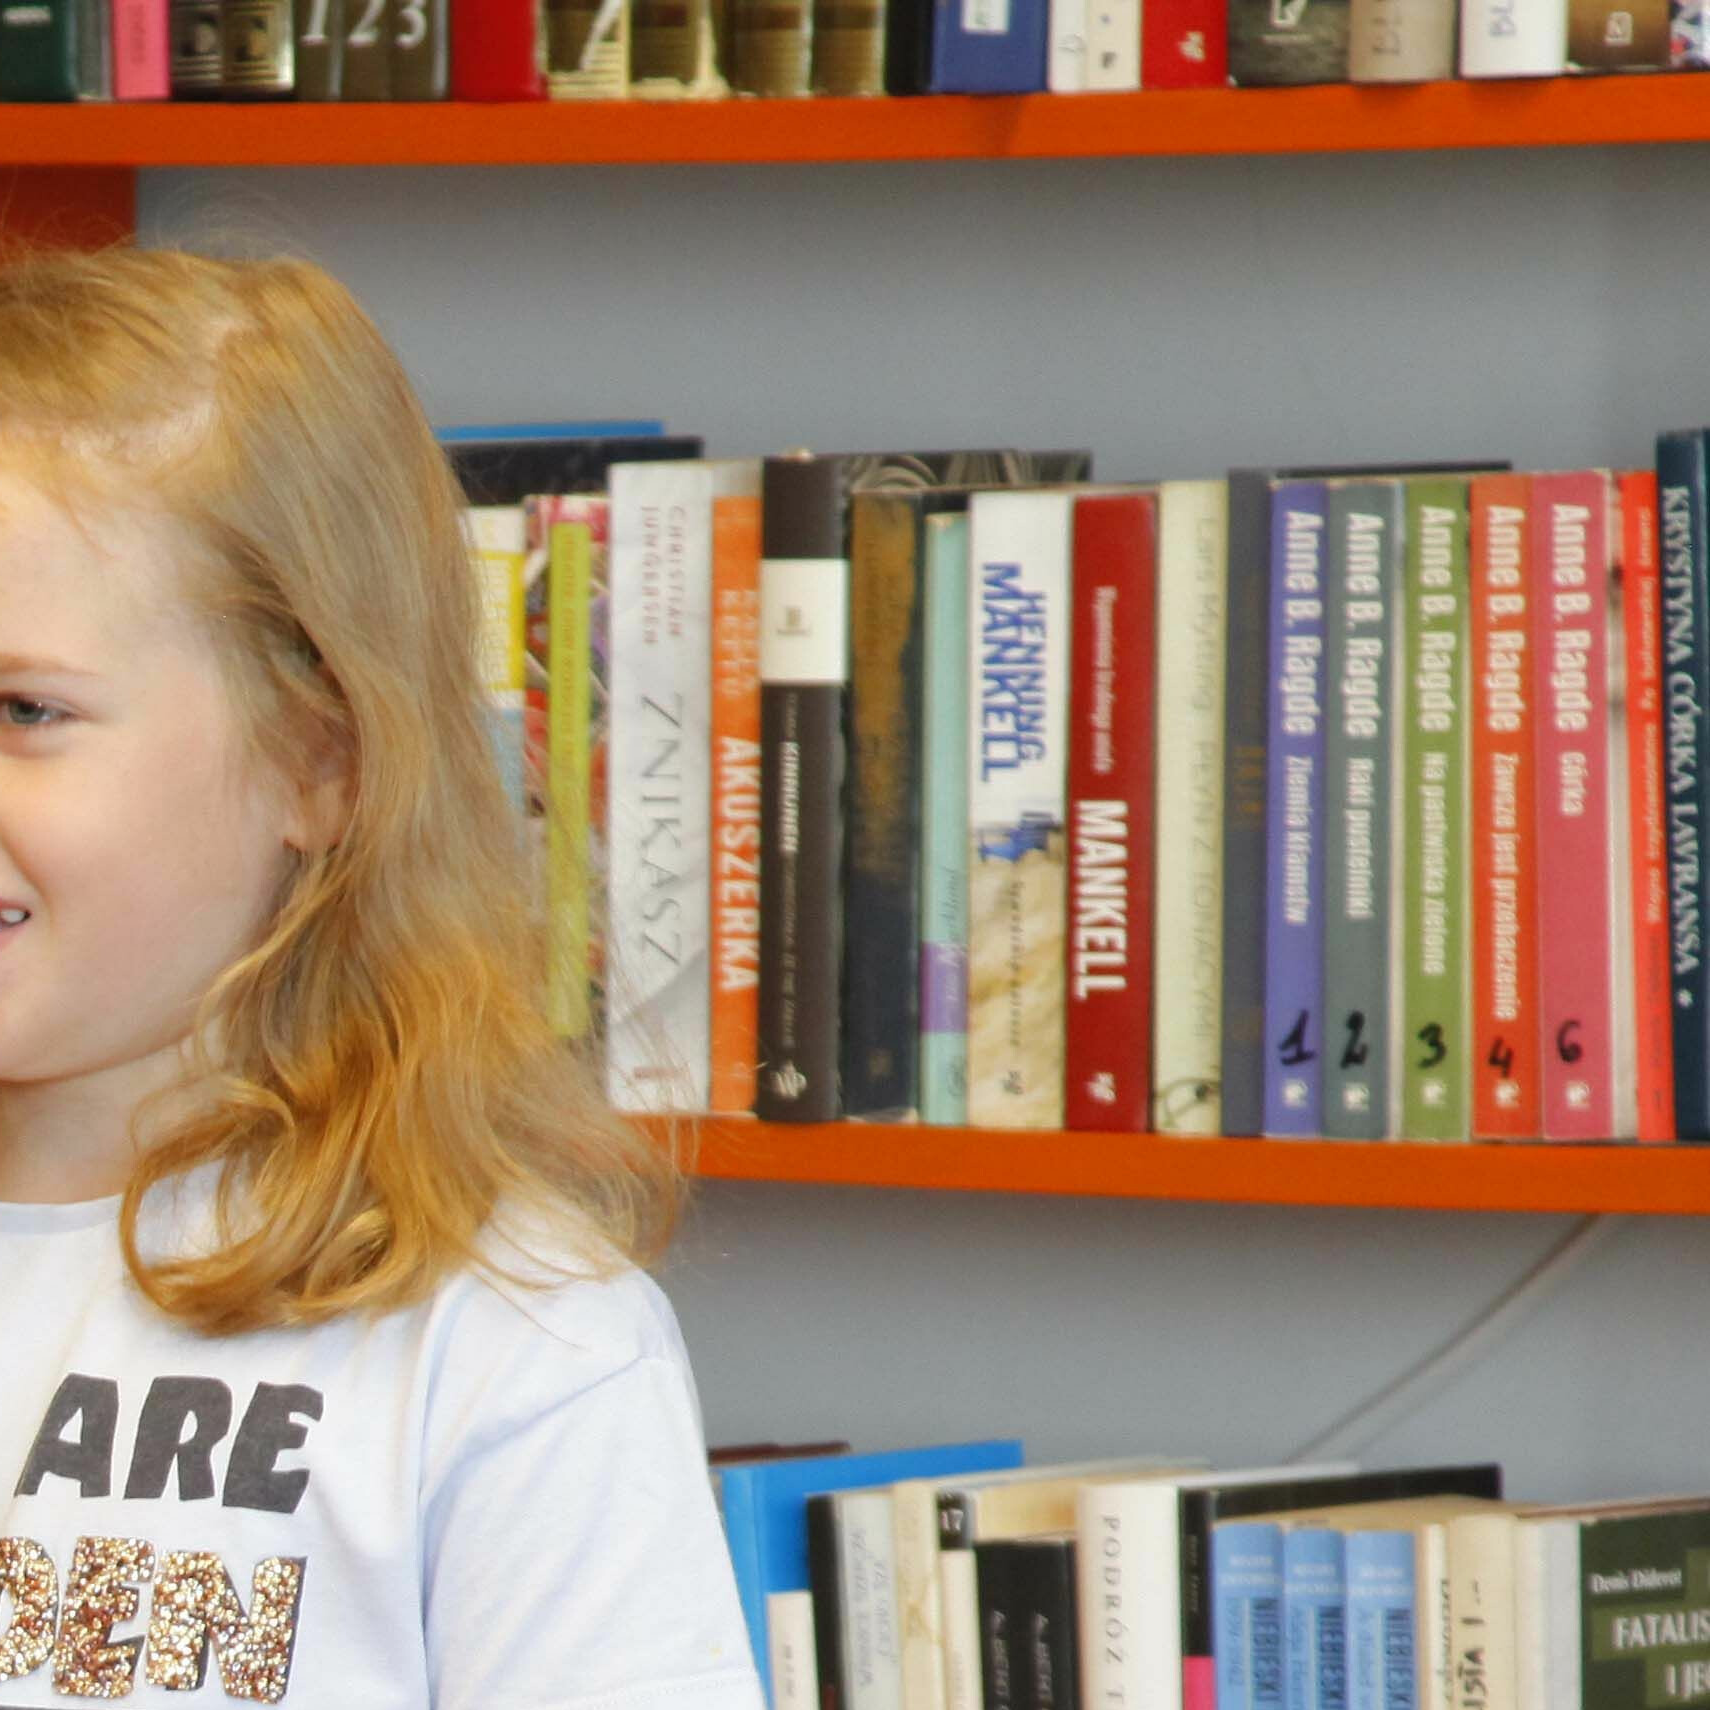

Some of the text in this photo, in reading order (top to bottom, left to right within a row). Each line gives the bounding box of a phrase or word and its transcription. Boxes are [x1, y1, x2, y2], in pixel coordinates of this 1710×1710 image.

[640, 504, 662, 647] JUNGERSEN
[666, 505, 687, 641] CHRISTIAN
[1196, 517, 1221, 585] Lars
[1422, 505, 1457, 588] Anne
[1554, 504, 1590, 587] Anne
[1188, 594, 1221, 713] Mytting
[1422, 593, 1457, 625] B.
[1554, 592, 1590, 624] B.
[980, 562, 1022, 783] MANKELL
[1015, 591, 1048, 763] HENNING
[1282, 509, 1323, 924] Anne B. Ragde Ziemia kłamstw
[1343, 510, 1384, 920] Anne B. Ragde Raki pustelniki
[1417, 631, 1458, 735] Ragde
[1549, 630, 1591, 734] Ragde
[1422, 751, 1447, 779] Na
[1486, 505, 1527, 1020] Anne B. Ragde Zawsze jest przebaczenie
[1661, 487, 1704, 974] KRYSTYNA CÓRKA LAVRANSA
[638, 691, 685, 967] ZNIKASZ
[779, 742, 802, 853] KINNUNEN
[717, 736, 761, 991] AKUSZERKA
[1074, 799, 1128, 1003] MANKELL
[1422, 897, 1450, 975] zielone
[1340, 1011, 1370, 1070] 2
[1416, 1023, 1447, 1070] 3
[1556, 1019, 1582, 1064] 6
[13, 1372, 324, 1514] ARE
[1099, 1515, 1130, 1666] PODRÓŻ
[1589, 1572, 1628, 1594] Denis
[991, 1611, 1014, 1700] ALBERT
[1032, 1613, 1055, 1705] ALBERT
[1250, 1597, 1279, 1703] NIEBIESKI
[1316, 1605, 1346, 1710] NIEBIESKI
[1665, 1664, 1677, 1697] I
